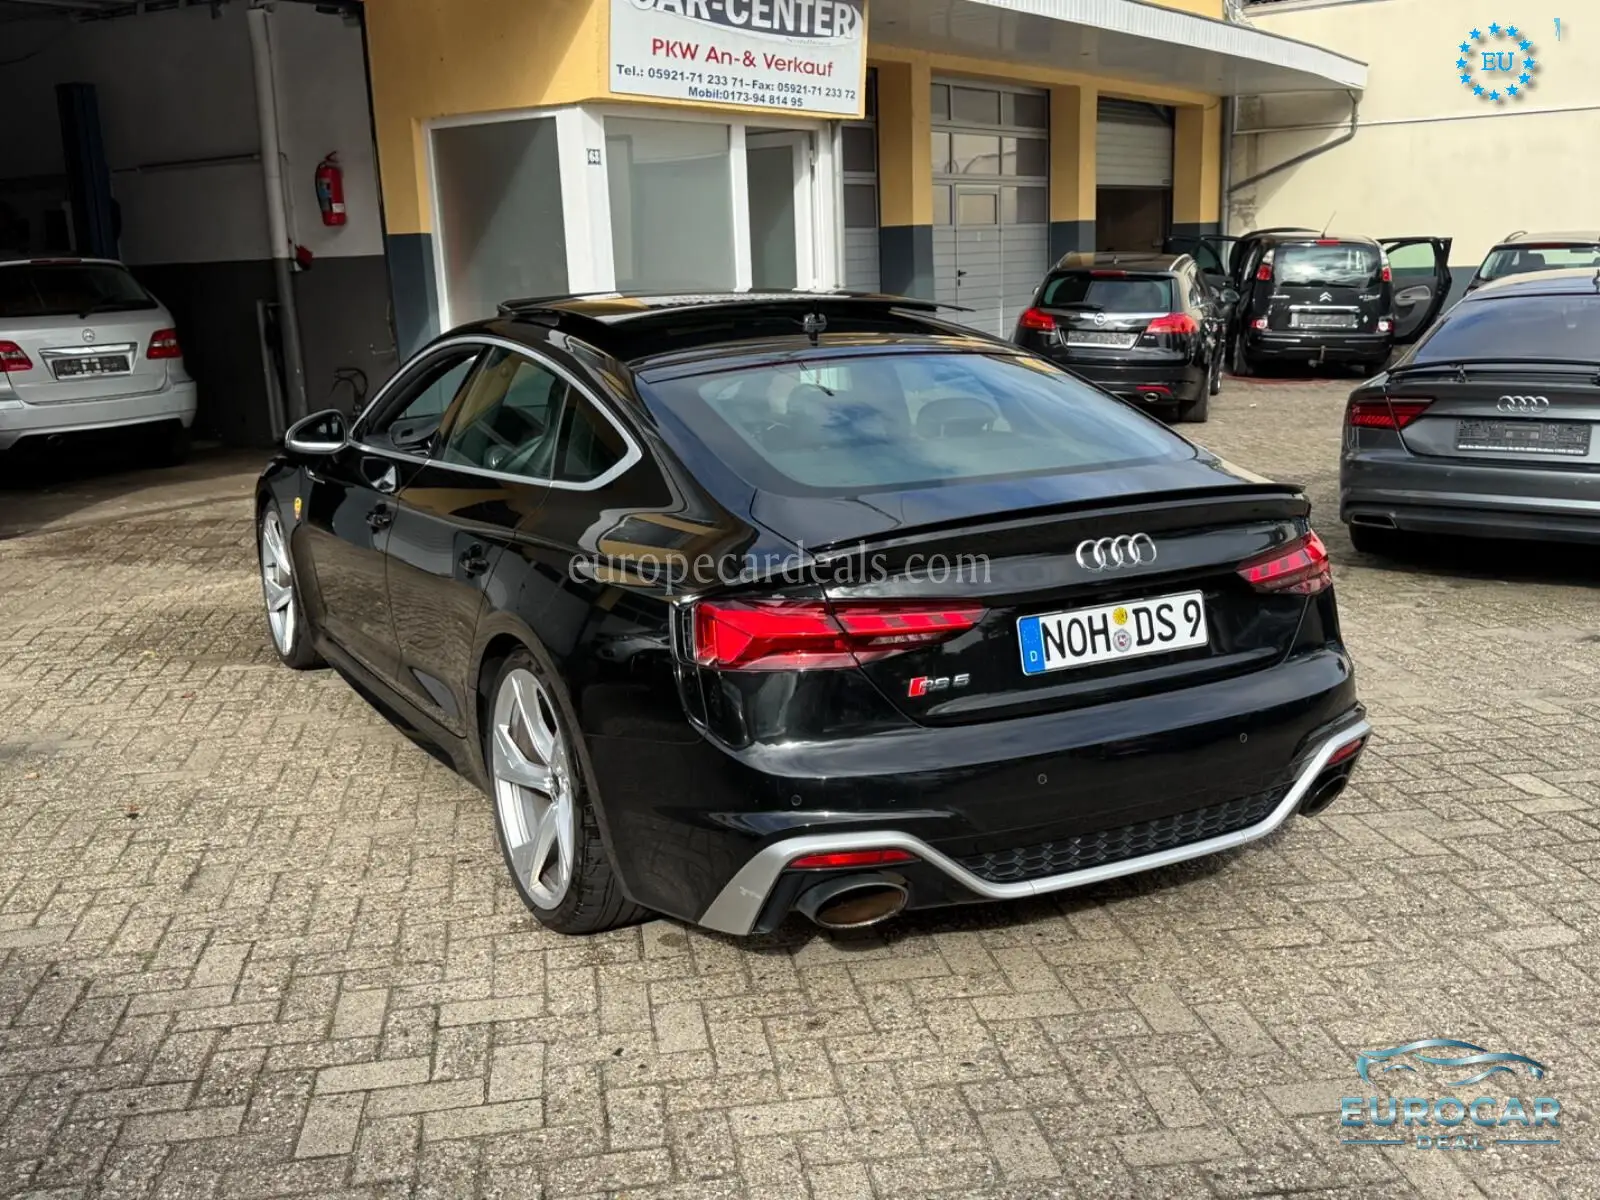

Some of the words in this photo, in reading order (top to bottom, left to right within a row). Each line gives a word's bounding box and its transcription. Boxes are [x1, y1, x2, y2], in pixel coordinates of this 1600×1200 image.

[630, 0, 853, 38] R-CENTER
[652, 37, 699, 60] PKW
[763, 53, 834, 77] Verkauf
[616, 63, 644, 77] Tel.:
[647, 67, 703, 83] 05921-71
[707, 74, 728, 86] 233
[777, 82, 822, 96] 05921-71
[825, 87, 842, 98] 233
[845, 89, 856, 99] 72
[769, 94, 788, 106] 814
[791, 97, 804, 107] 95
[1040, 612, 1112, 662] NOH
[1132, 602, 1177, 648] DS
[1183, 599, 1202, 638] 9
[1029, 650, 1038, 662] D
